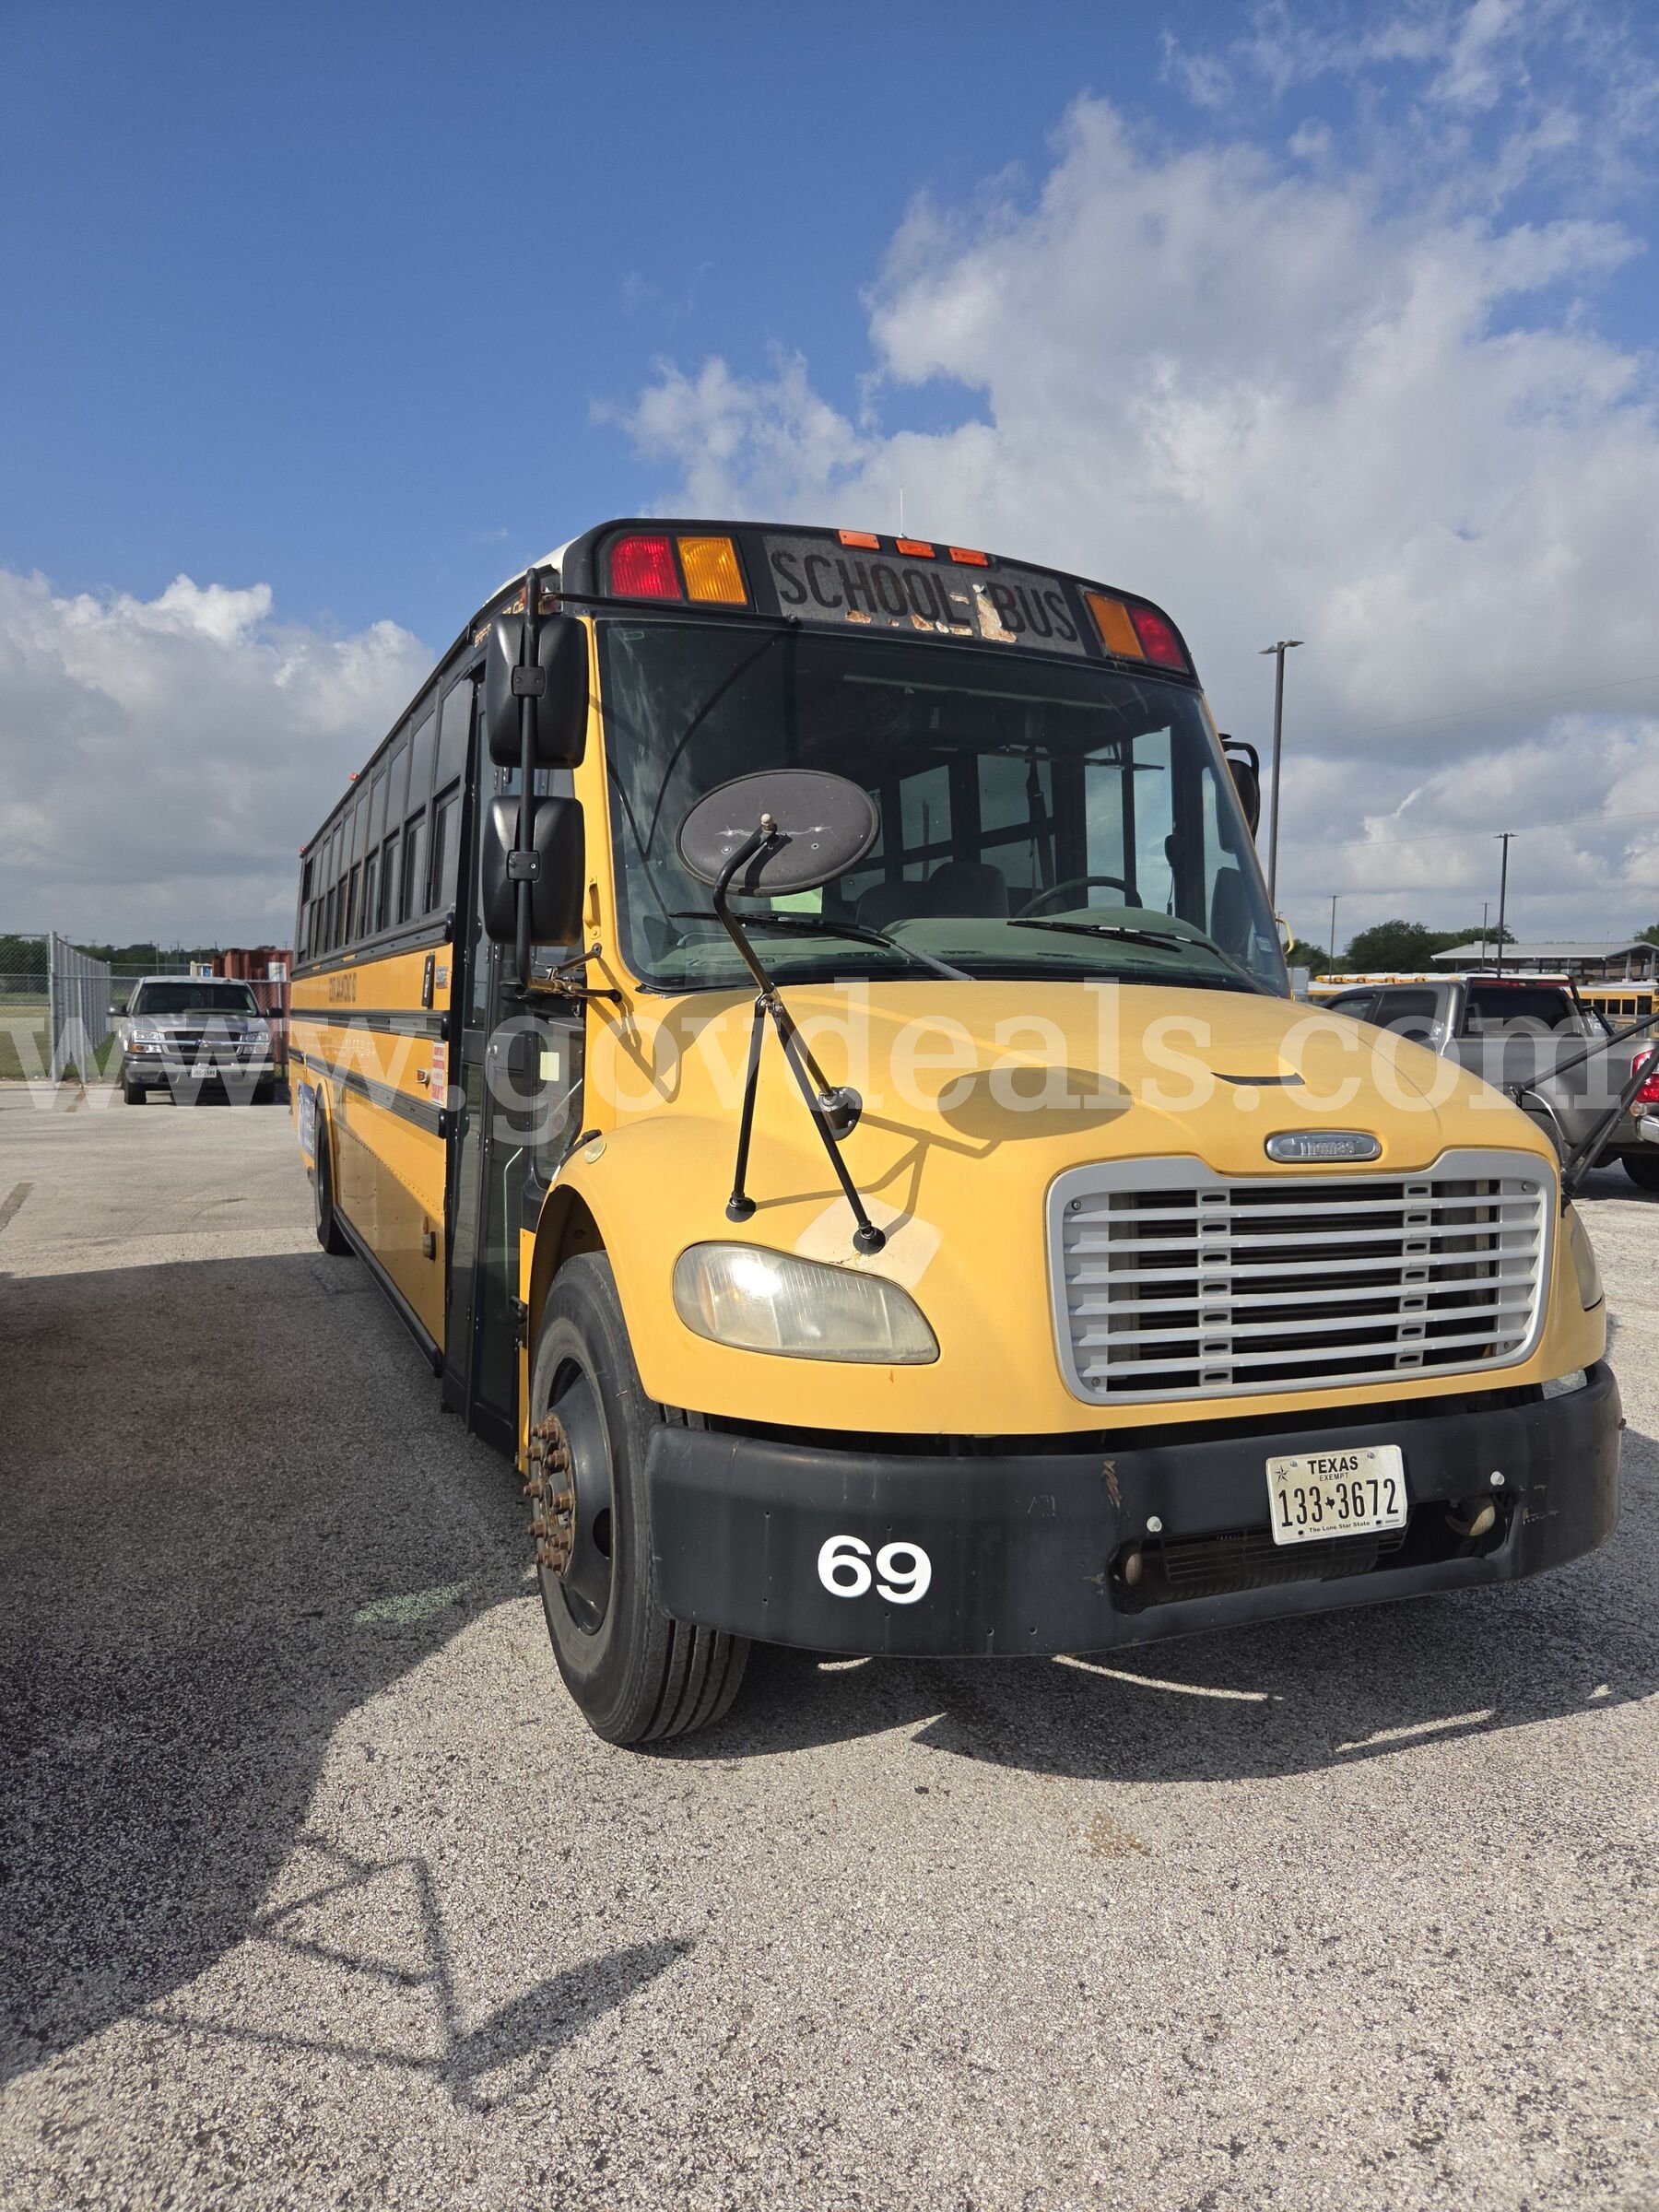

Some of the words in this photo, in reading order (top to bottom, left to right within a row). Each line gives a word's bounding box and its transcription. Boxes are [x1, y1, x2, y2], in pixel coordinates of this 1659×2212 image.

[771, 550, 971, 625] SCHOOL
[985, 582, 1078, 642] BUS
[1307, 1456, 1358, 1475] TEXAS
[1319, 1472, 1349, 1482] EXEMPT
[818, 1535, 932, 1605] 69
